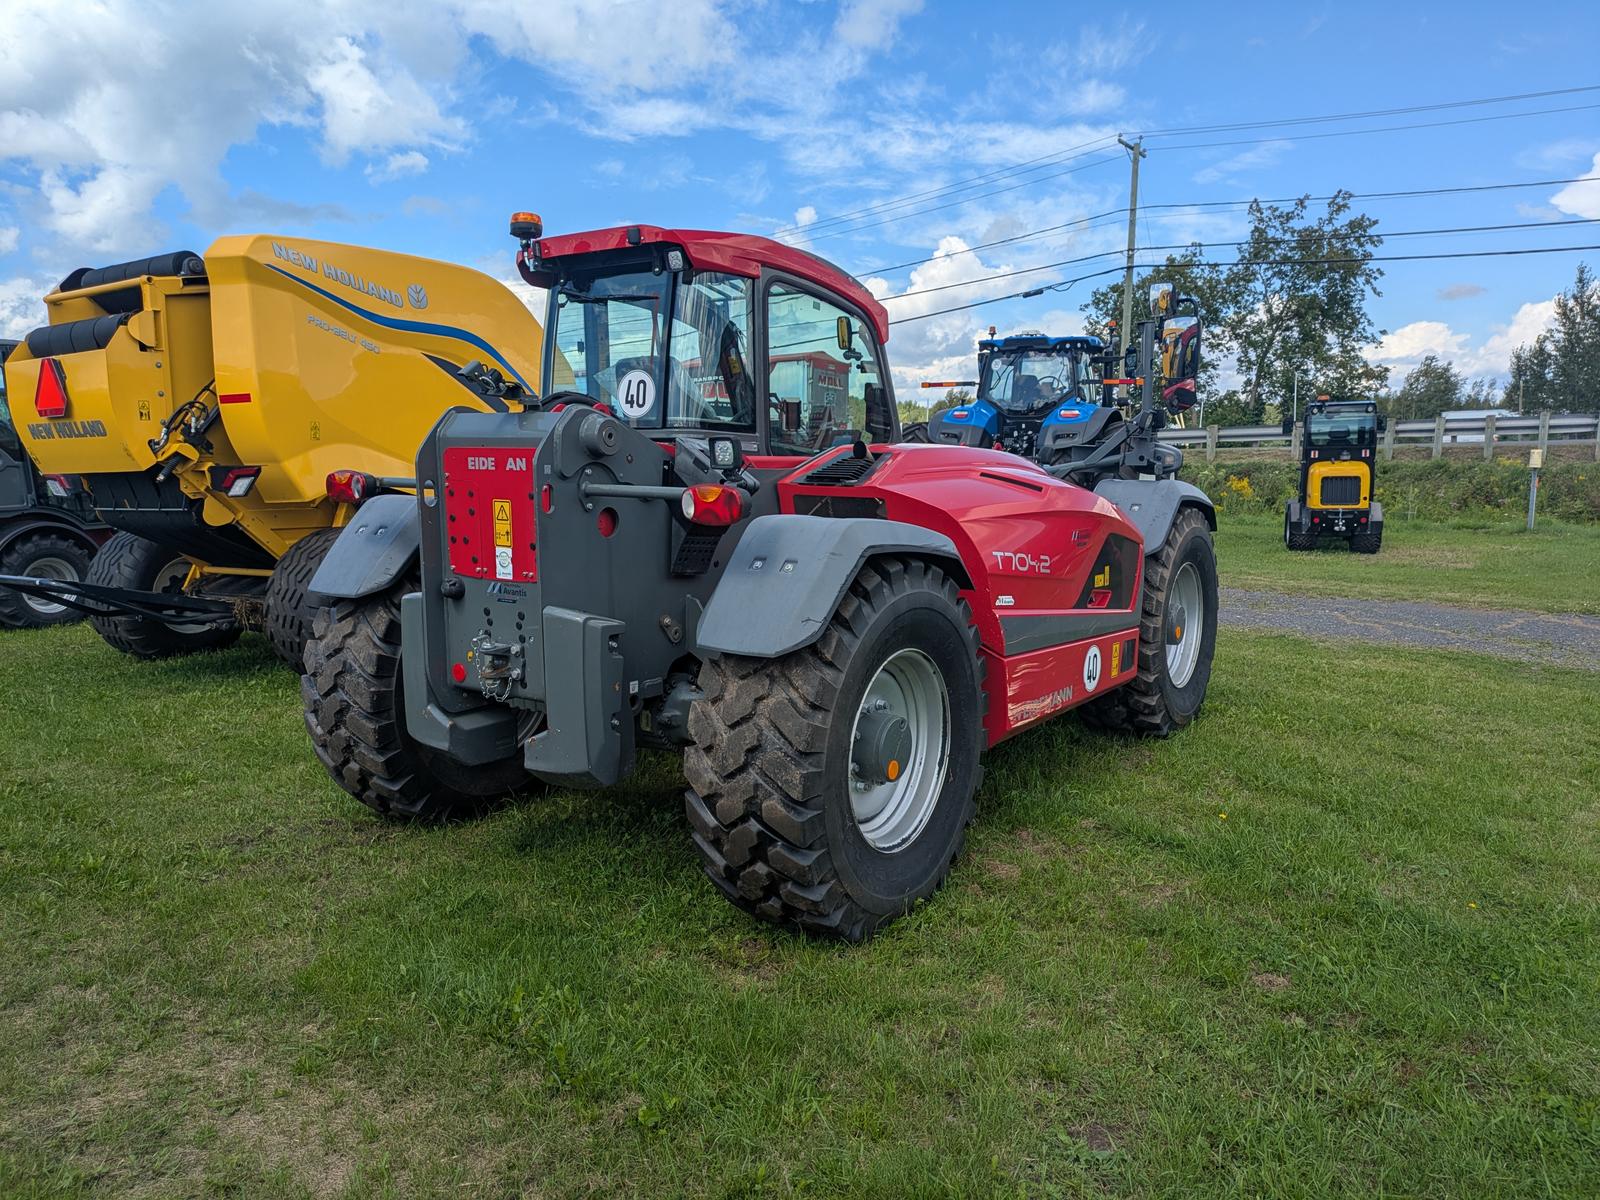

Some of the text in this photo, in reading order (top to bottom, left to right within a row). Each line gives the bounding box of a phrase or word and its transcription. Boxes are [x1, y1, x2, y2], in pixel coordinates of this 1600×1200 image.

[271, 241, 404, 308] NEW HOLLAND
[307, 314, 357, 344] PRO-BELT
[625, 379, 647, 409] 40
[27, 420, 108, 440] NEW HOLLAND
[467, 456, 527, 471] EIDE AN
[992, 551, 1051, 574] T7042
[1086, 653, 1098, 683] 40
